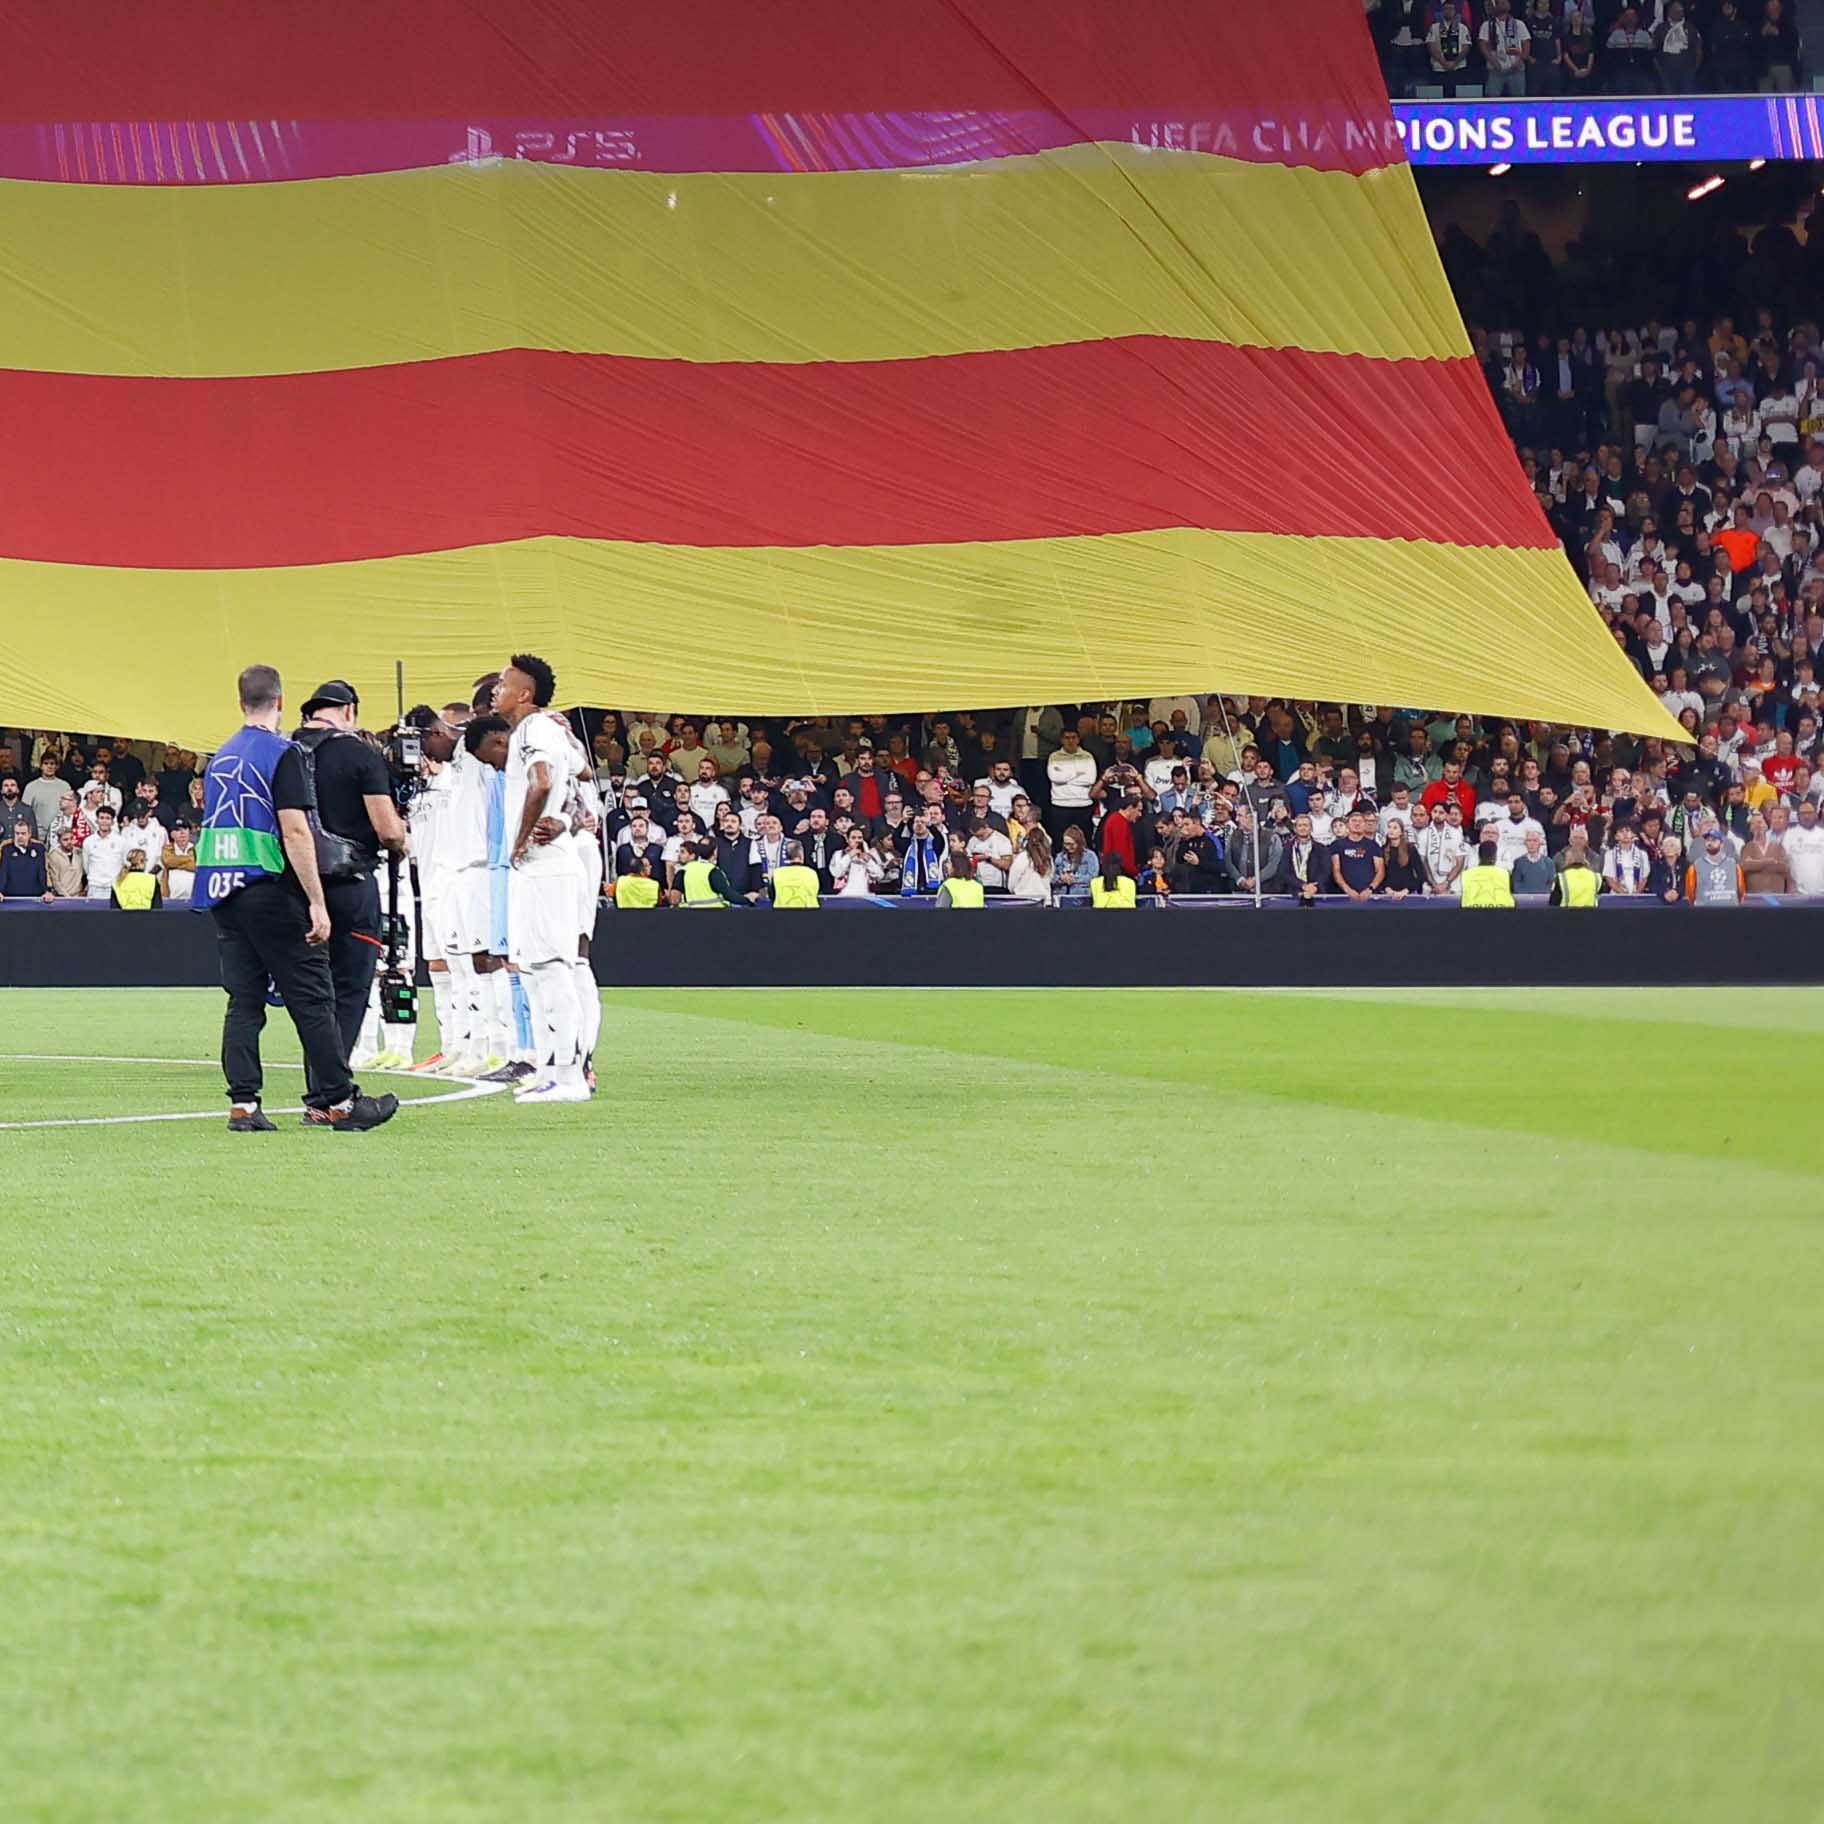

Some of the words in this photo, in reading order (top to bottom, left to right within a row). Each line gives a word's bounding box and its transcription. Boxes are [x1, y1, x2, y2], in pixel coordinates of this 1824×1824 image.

[1253, 114, 1514, 153] CHAMPIONS
[1528, 114, 1697, 151] LEAGUE
[214, 832, 240, 861] HB
